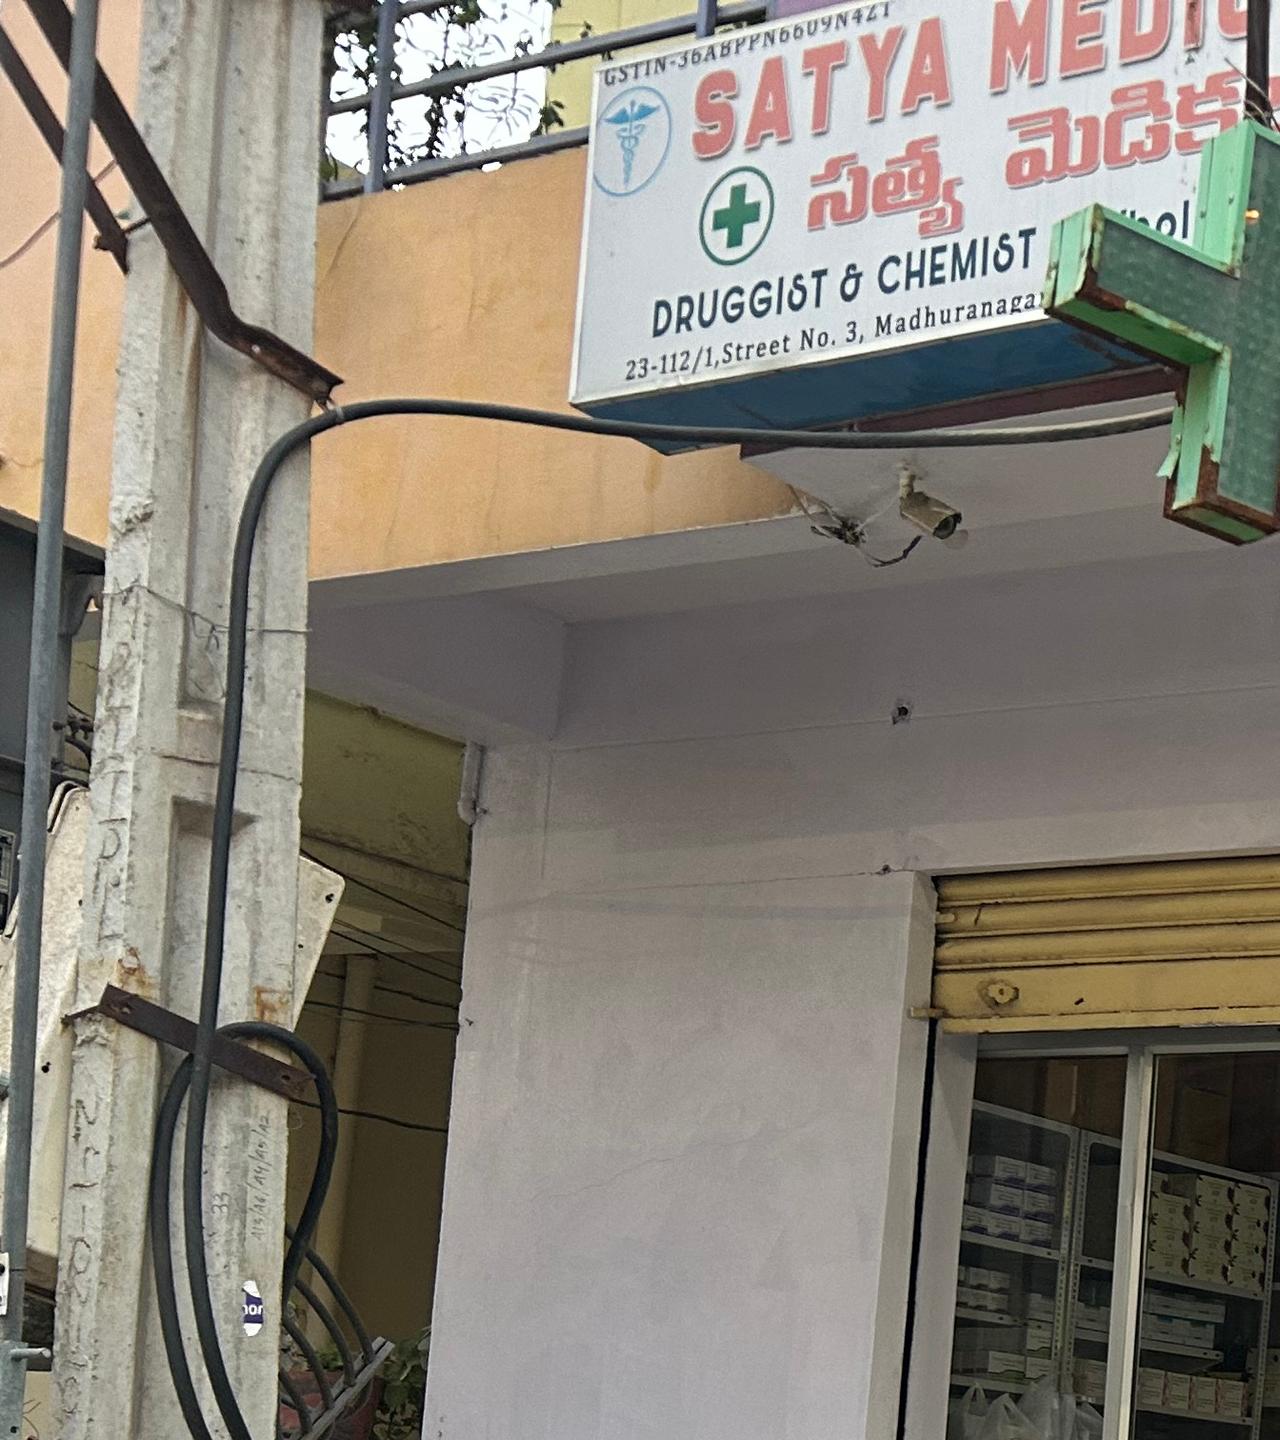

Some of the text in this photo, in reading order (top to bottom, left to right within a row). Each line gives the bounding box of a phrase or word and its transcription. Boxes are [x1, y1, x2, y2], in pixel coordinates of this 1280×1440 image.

[692, 16, 953, 160] SATYA
[652, 227, 1038, 338] DRUGGIST & CHEMIST
[800, 329, 836, 352] No.
[845, 321, 865, 345] 3,
[875, 292, 1045, 338] Madhuranaga
